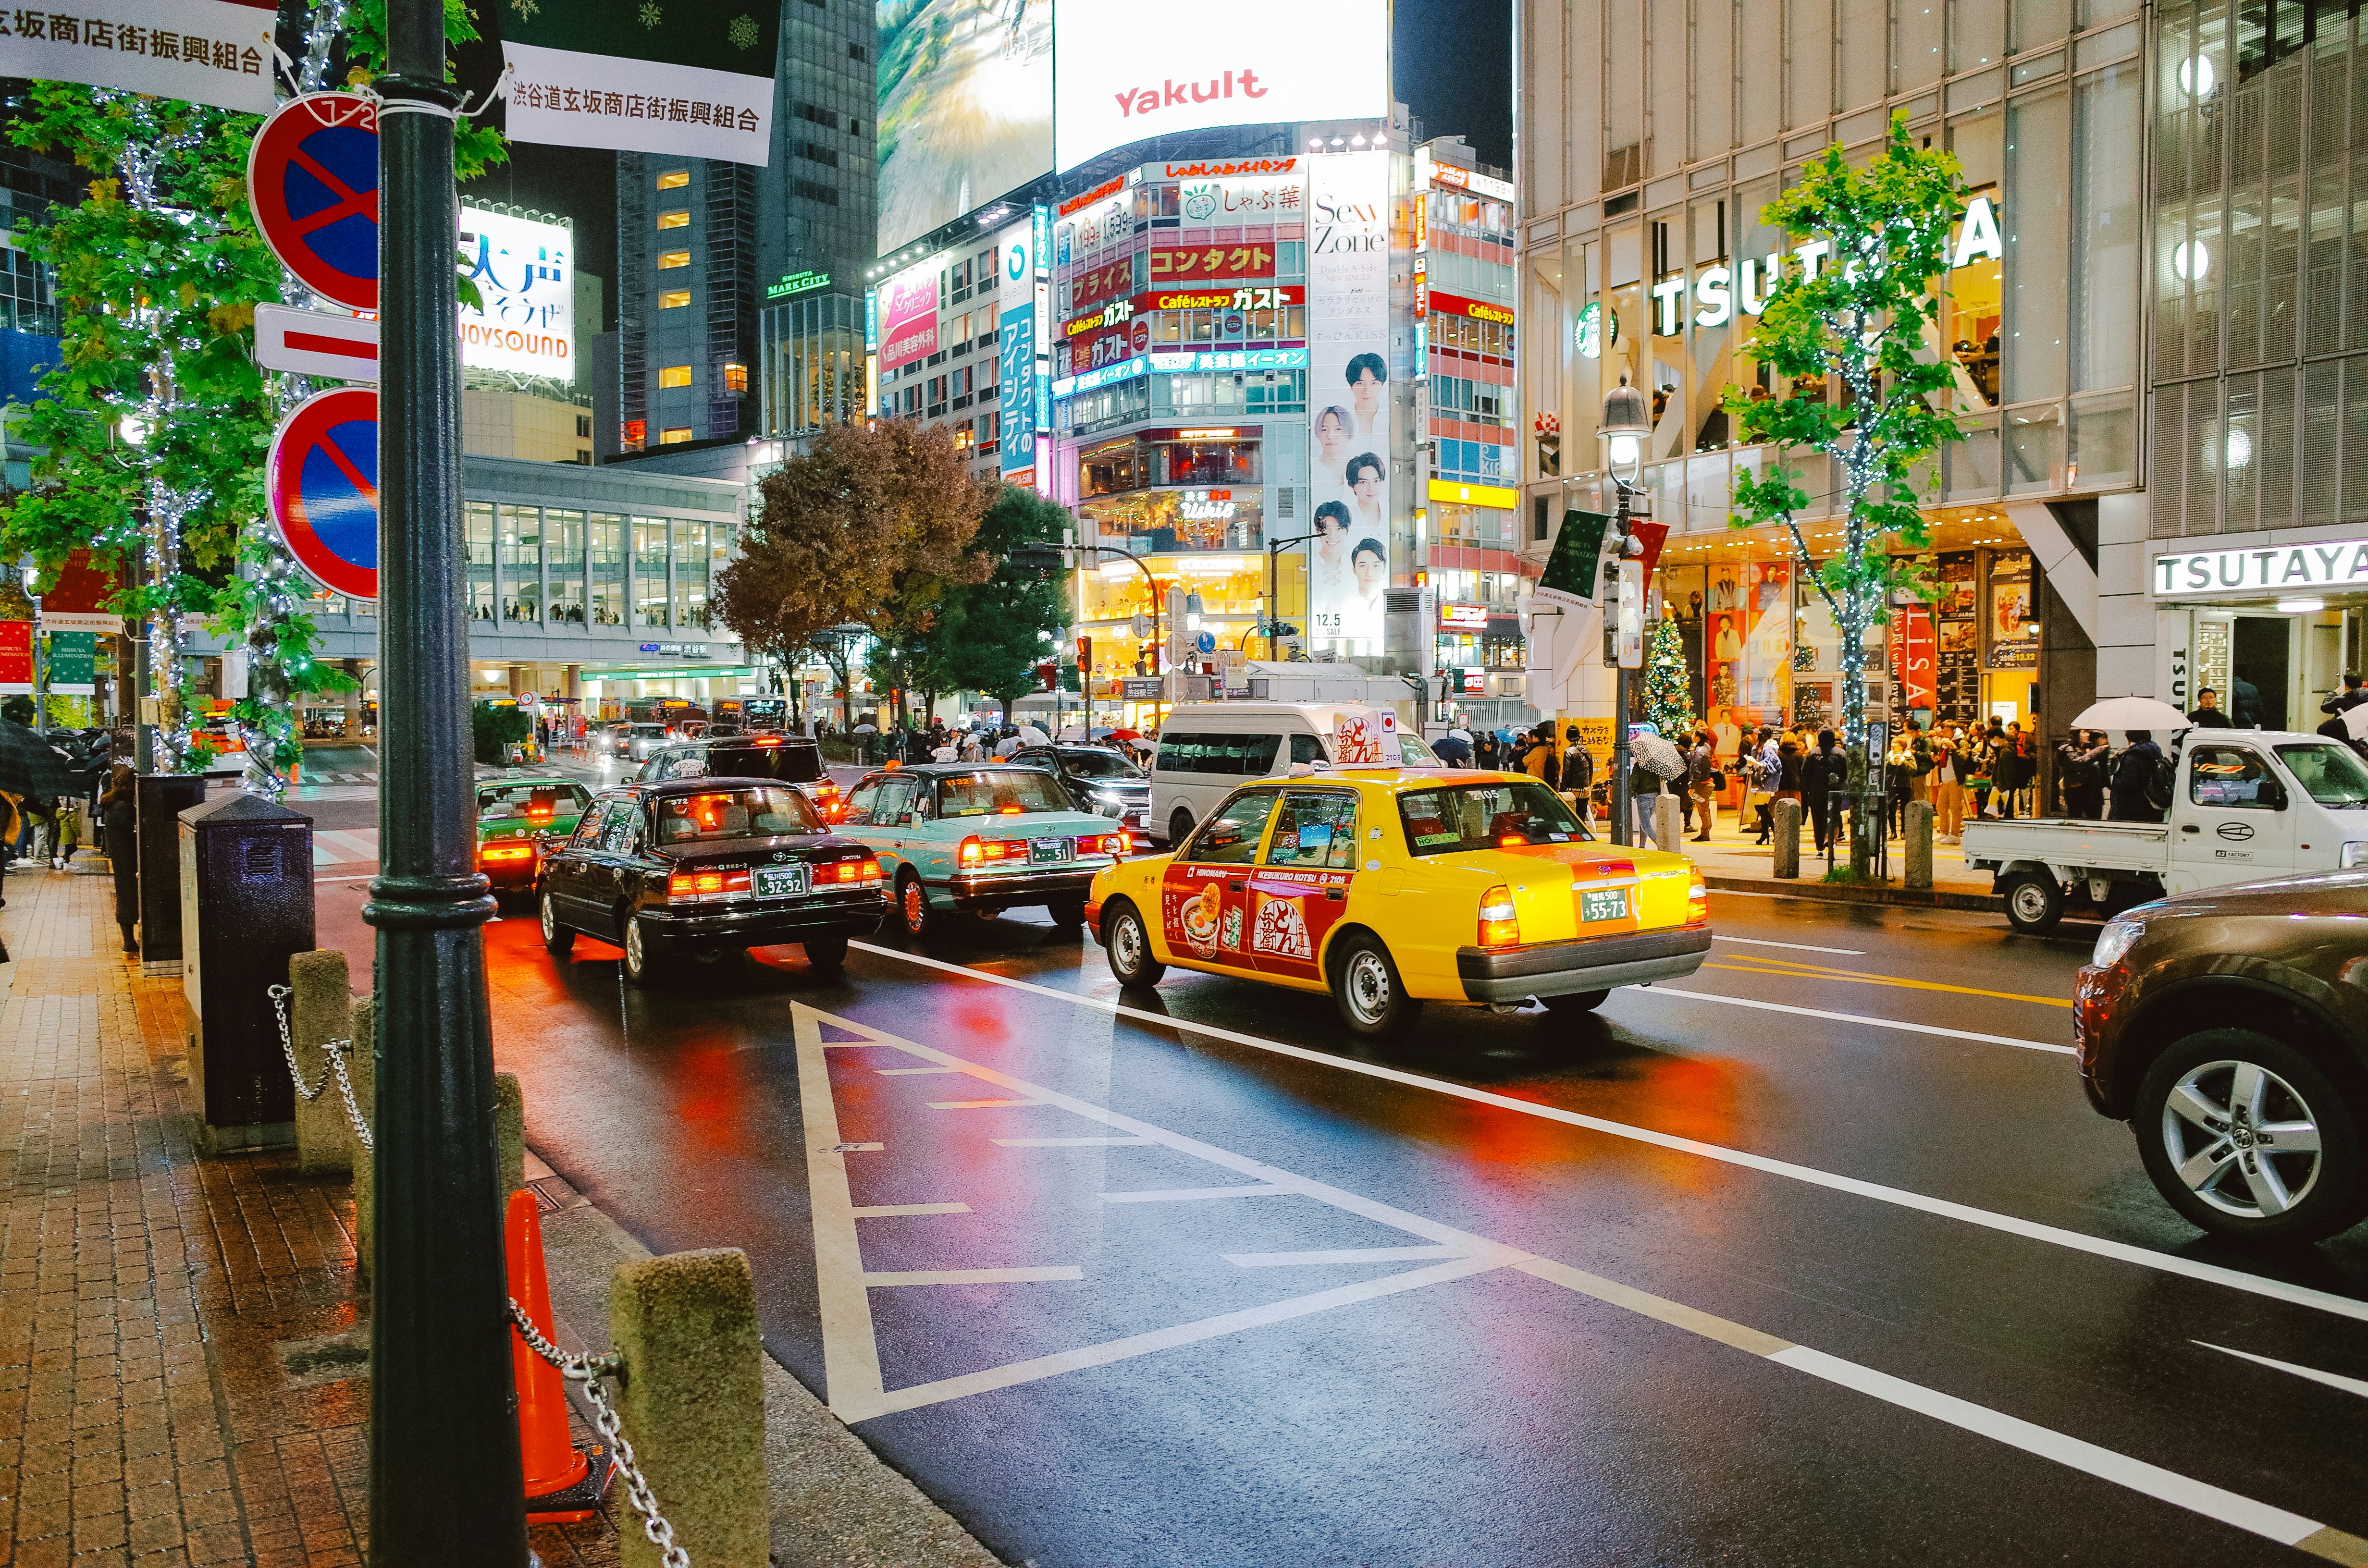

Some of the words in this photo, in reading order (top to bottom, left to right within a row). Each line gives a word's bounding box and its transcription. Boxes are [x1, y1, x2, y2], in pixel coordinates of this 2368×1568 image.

[1115, 68, 1268, 118] Yakult
[513, 81, 761, 133] 渋谷道玄坂商店街振興組合
[1225, 185, 1300, 212] しゃぶ葉
[1315, 194, 1377, 233] Sexy
[1314, 226, 1384, 254] Zone
[1151, 246, 1271, 272] コンタクト
[767, 281, 800, 295] MARK
[801, 273, 829, 287] CITY
[1004, 280, 1030, 300] eyecity
[1073, 261, 1131, 302] プライス
[904, 291, 932, 315] クリニック
[1233, 288, 1291, 311] ガスト
[1318, 295, 1382, 306] カラクリだらけの
[1416, 283, 1425, 312] ガスト
[1103, 299, 1135, 328] ガスト
[1329, 306, 1371, 316] テンダネス
[460, 322, 567, 358] JOYSOUND
[887, 327, 935, 362] 品川美容外科
[1092, 333, 1128, 369] ガスト
[1003, 322, 1019, 456] アイシティ
[1021, 318, 1032, 453] コンタクトの
[2157, 544, 2368, 590] TSUTAYA
[1316, 614, 1340, 626] 12.5
[1908, 611, 1934, 703] LiSA
[1891, 680, 1902, 708] loves
[1582, 725, 1609, 735] カメラを
[1473, 789, 1500, 800] 2105
[1055, 848, 1066, 860] 51
[767, 879, 802, 894] 92-92
[1196, 869, 1227, 878] HINOMARU
[1257, 871, 1294, 881] IKEBUKURO
[1294, 874, 1317, 882] KOTSU
[1329, 875, 1346, 884] 2105
[1605, 891, 1617, 900] 500
[1591, 900, 1627, 920] 55-73
